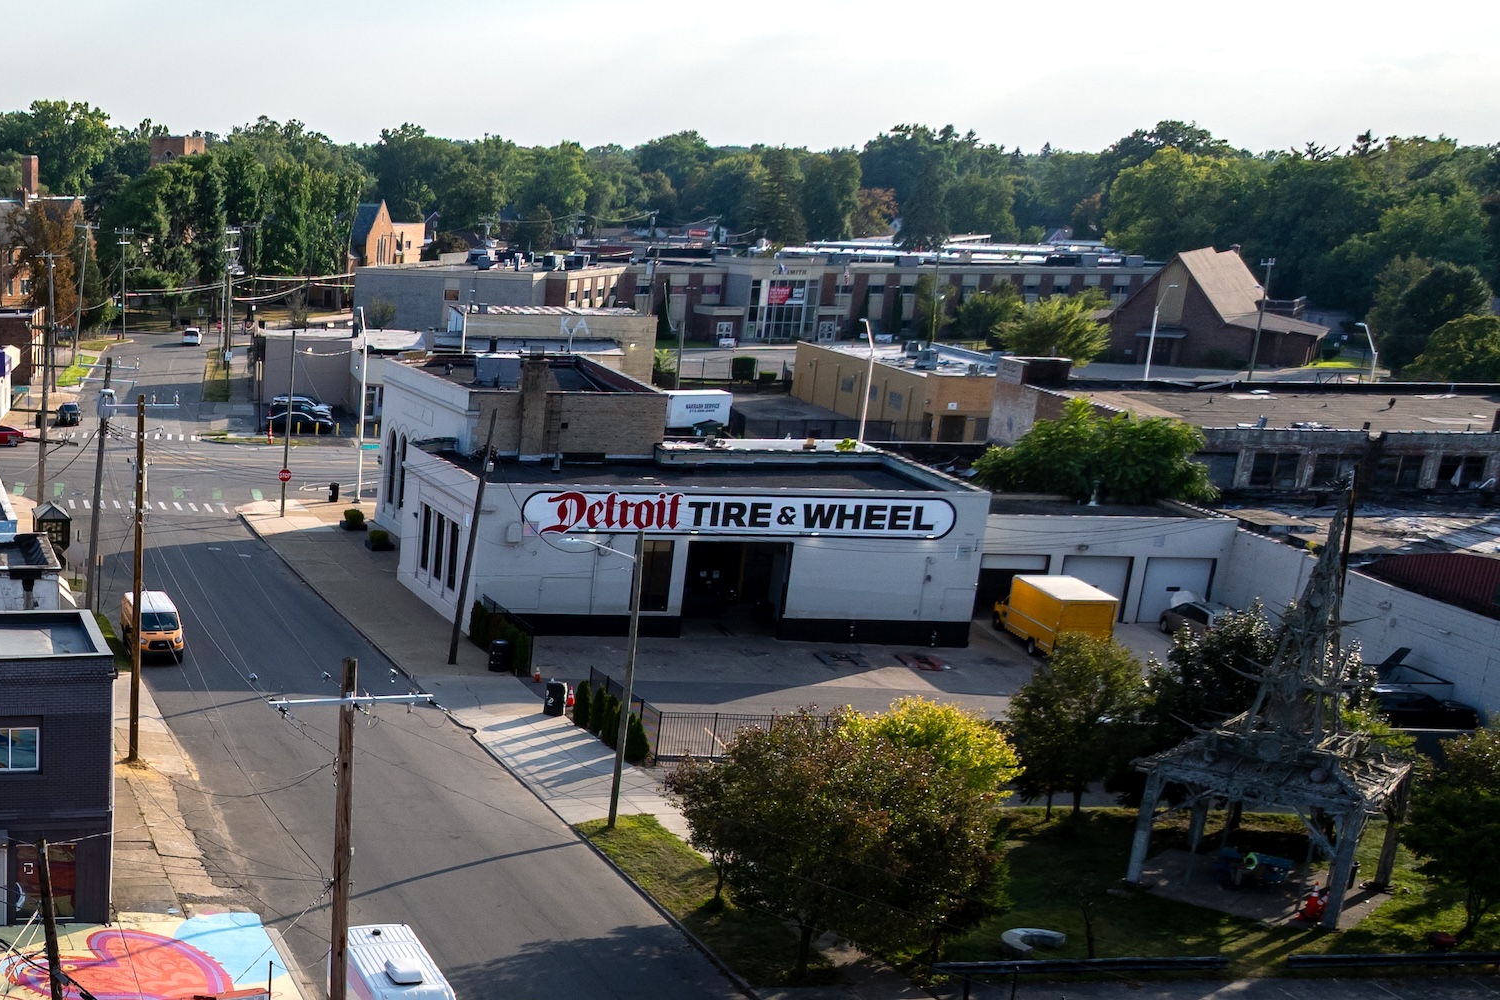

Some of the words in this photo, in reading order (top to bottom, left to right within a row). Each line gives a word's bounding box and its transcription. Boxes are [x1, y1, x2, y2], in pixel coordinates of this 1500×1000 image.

[540, 490, 685, 535] Detroit
[688, 501, 773, 528] TIRE
[776, 505, 796, 526] &
[803, 503, 935, 532] WHEEL
